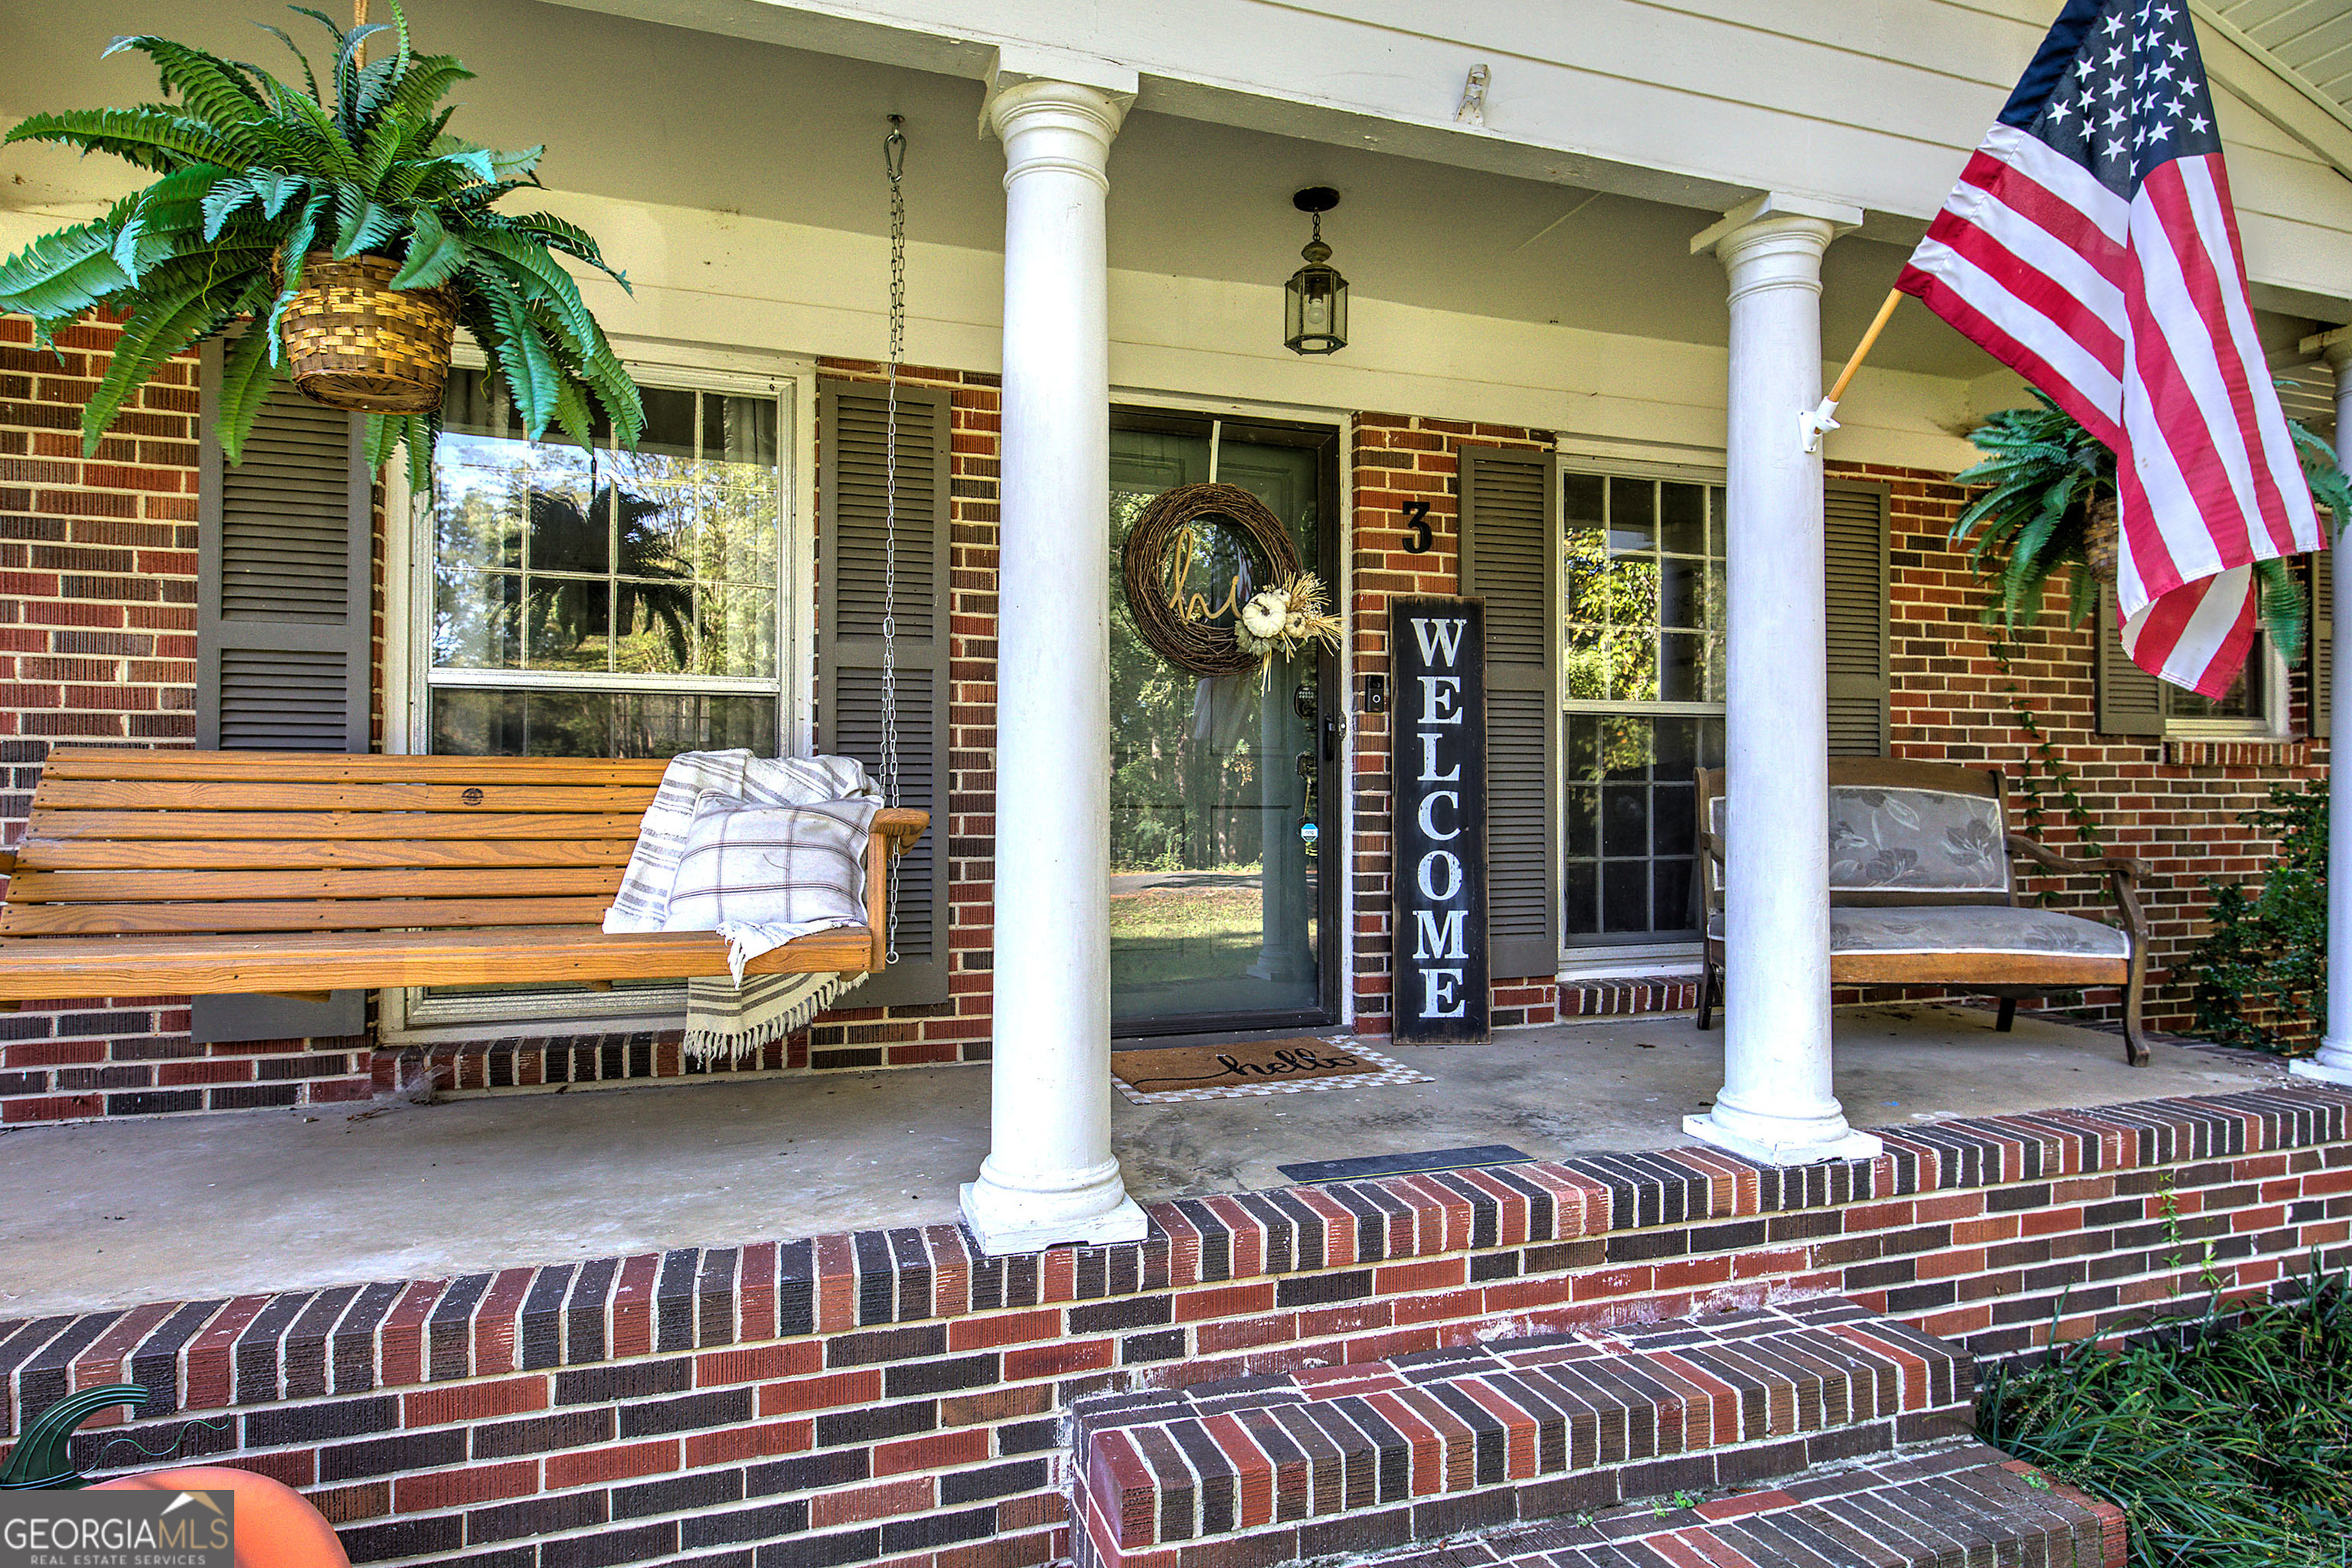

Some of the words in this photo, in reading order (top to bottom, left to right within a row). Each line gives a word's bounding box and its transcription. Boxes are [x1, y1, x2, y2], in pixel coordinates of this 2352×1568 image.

[1402, 501, 1432, 554] 3
[1410, 618, 1469, 1018] WELCOME
[1133, 1047, 1357, 1086] hello
